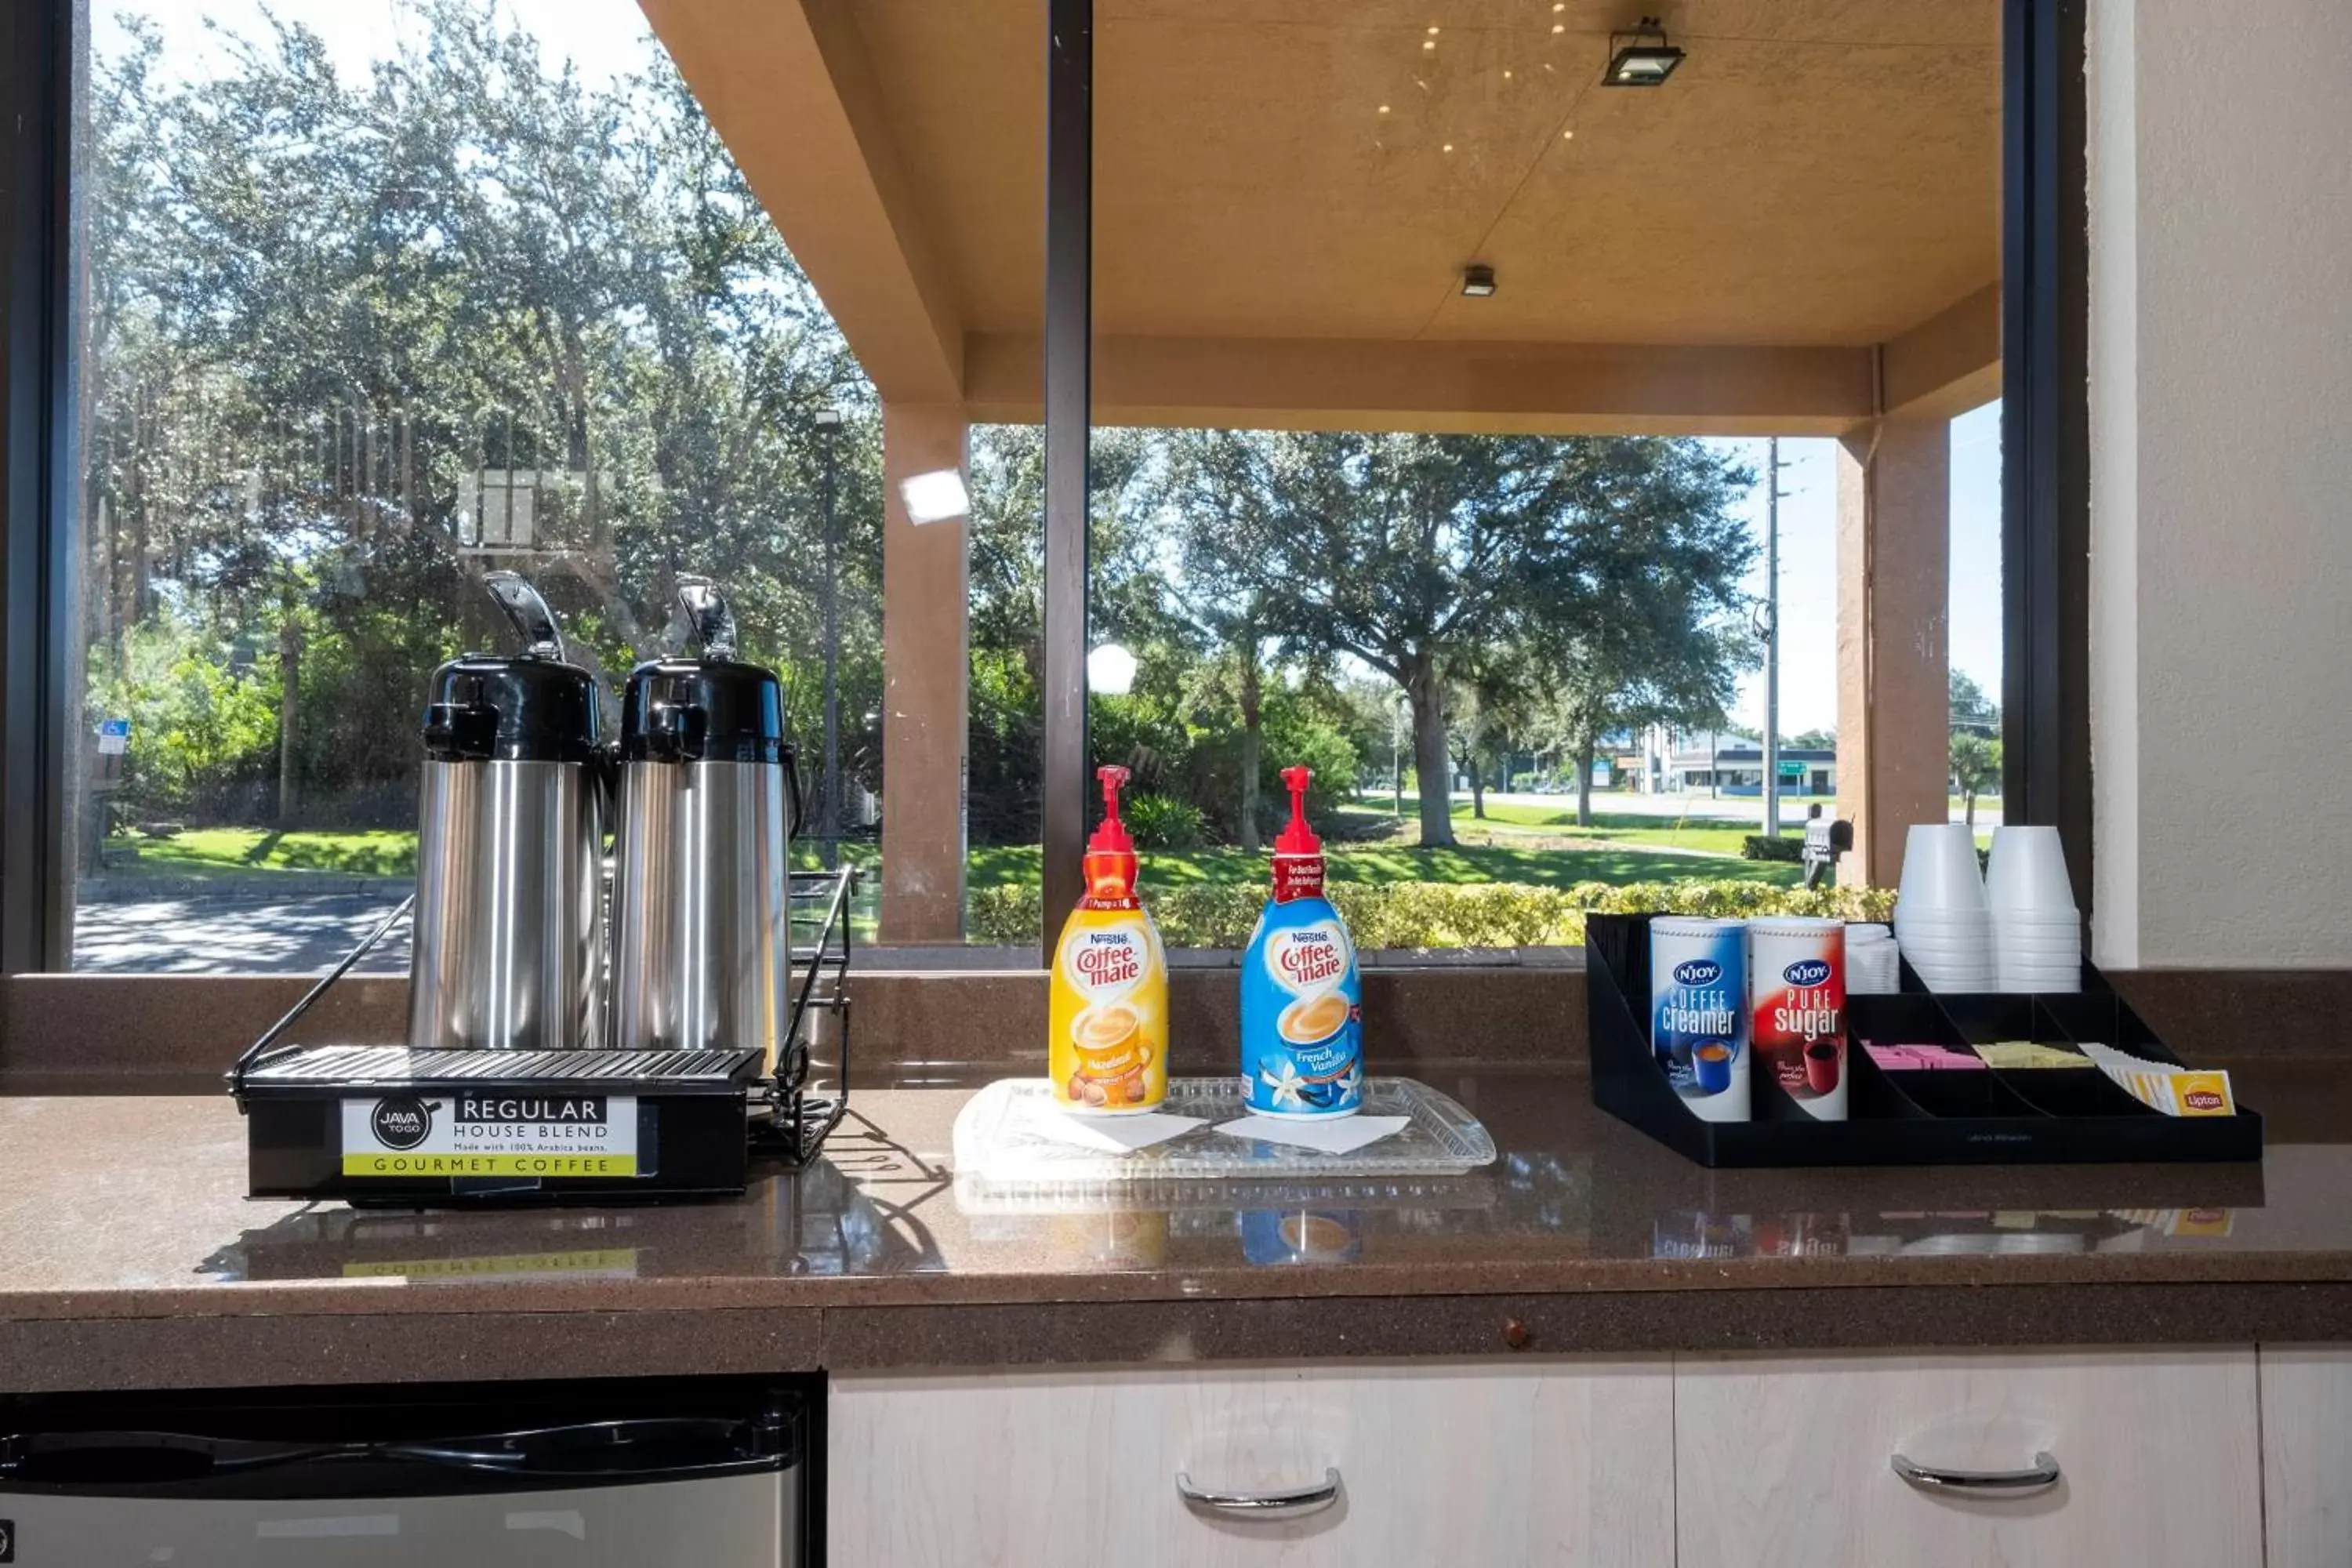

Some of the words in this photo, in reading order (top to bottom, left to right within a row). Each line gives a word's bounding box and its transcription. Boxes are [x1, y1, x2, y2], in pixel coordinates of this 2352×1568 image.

[1291, 931, 1328, 942] Nestlé
[1091, 962, 1139, 985] mate
[1297, 958, 1340, 983] mate
[1669, 988, 1726, 1011] COFFEE
[1788, 988, 1831, 1011] PURE
[1296, 1046, 1333, 1063] French
[2188, 1094, 2221, 1107] Lipton
[463, 1100, 597, 1120] REGULAR
[380, 1112, 419, 1124] JAVA
[454, 1125, 526, 1138] HOUSE
[539, 1125, 608, 1138] BLEND
[454, 1142, 479, 1151] Made
[483, 1142, 504, 1151] with
[510, 1142, 534, 1152] 100%
[537, 1142, 574, 1152] Arabica
[374, 1158, 497, 1171] GOURMET
[514, 1159, 609, 1172] COFFEE
